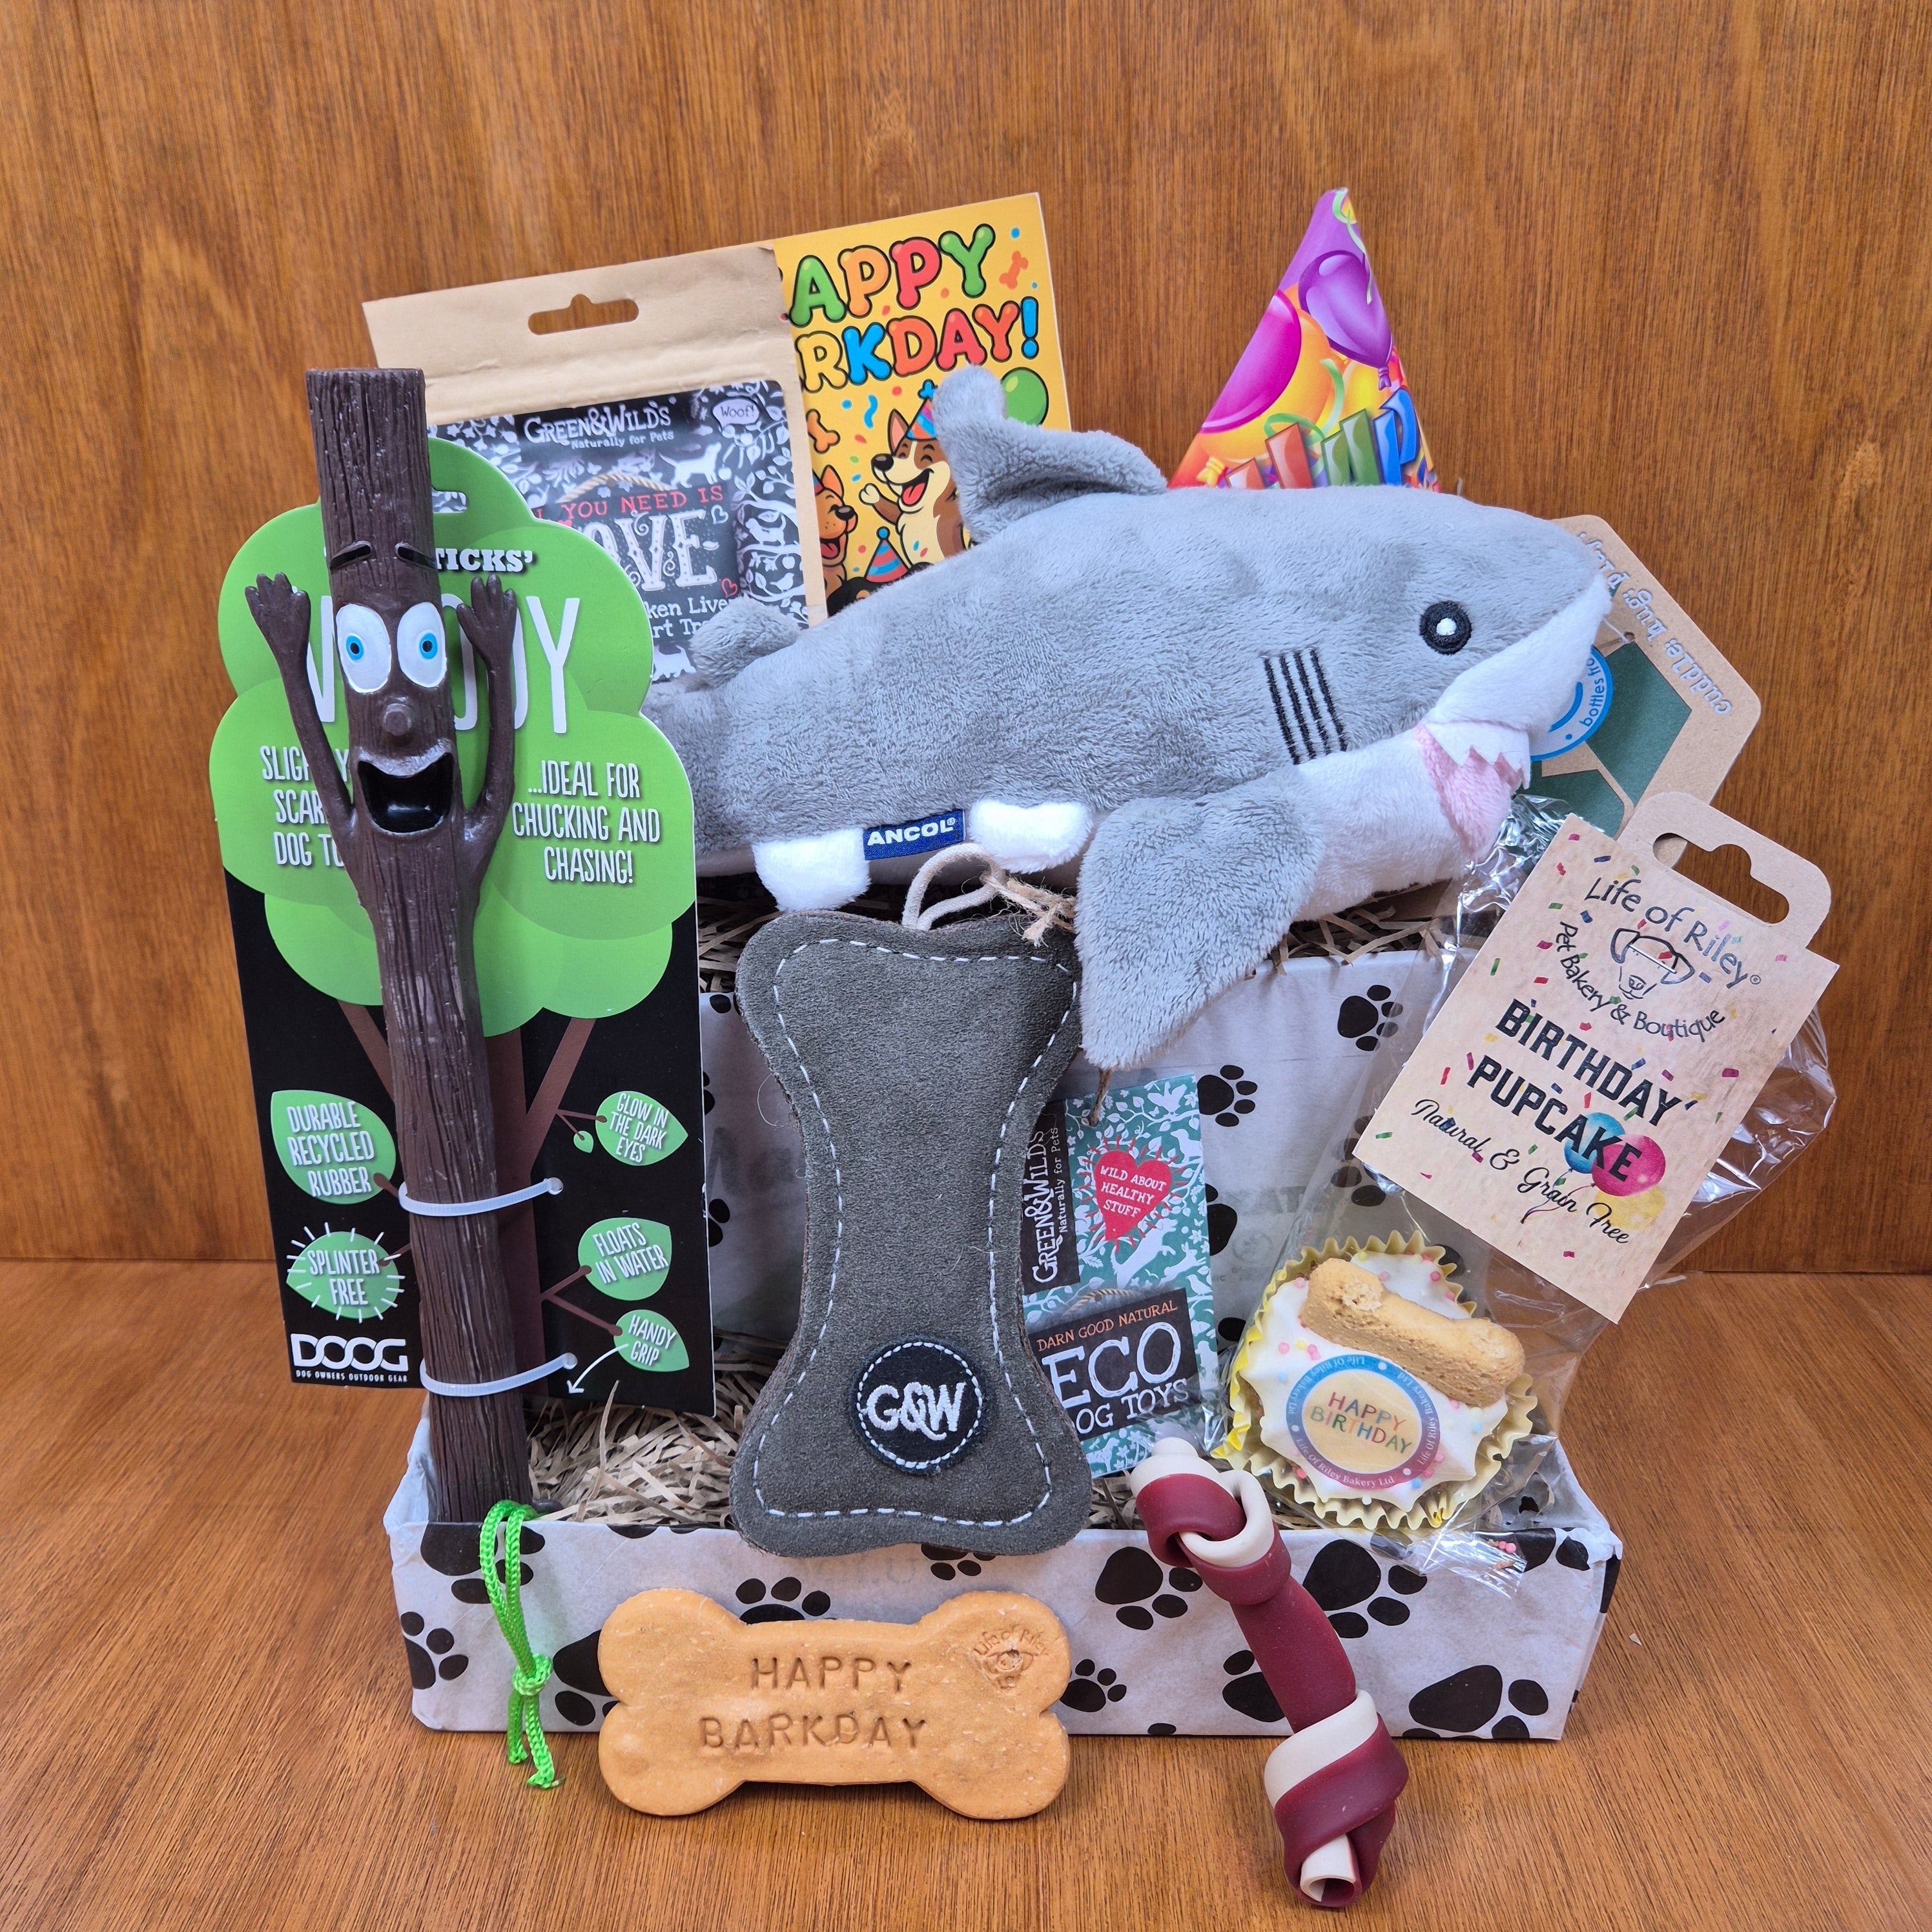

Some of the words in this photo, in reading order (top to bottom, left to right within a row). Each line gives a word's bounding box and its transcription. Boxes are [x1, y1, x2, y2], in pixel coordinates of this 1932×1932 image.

[790, 223, 996, 327] APPY
[795, 296, 1039, 393] RKDAY!
[720, 405, 757, 420] Woof!
[571, 436, 625, 450] Naturally
[629, 435, 646, 446] for
[650, 429, 674, 442] Pets
[561, 500, 608, 520] YOU
[621, 491, 687, 514] NEED
[697, 485, 723, 503] IS
[435, 548, 533, 573] TICKS'
[581, 509, 718, 592] OVE
[1586, 655, 1605, 677] fro
[1579, 677, 1605, 728] bottles
[260, 745, 349, 782] SLIGY
[606, 762, 641, 798] FOR
[512, 802, 609, 841] CHUCKING
[618, 807, 661, 842] AND
[273, 831, 313, 867] DOG
[318, 834, 345, 867] TO
[544, 846, 633, 884] CHASING!
[1584, 877, 1642, 912] Life
[1645, 906, 1695, 932] of
[1556, 921, 1578, 952] Pet
[1560, 953, 1612, 1012] Bakery
[1610, 1004, 1631, 1025] &
[1633, 1009, 1726, 1043] Boutique
[1495, 998, 1683, 1127] BIRTHDAY
[286, 1100, 362, 1133] DURABLE
[616, 1093, 653, 1122] GLOW
[653, 1107, 670, 1129] IN
[1466, 1054, 1642, 1182] PUPCAKE
[287, 1130, 375, 1166] RECYCLED
[609, 1111, 633, 1136] THE
[633, 1121, 667, 1150] DARK
[1051, 1127, 1061, 1153] Pets
[615, 1136, 646, 1163] EYES
[1053, 1158, 1062, 1175] for
[307, 1166, 372, 1198] RUBBER
[1100, 1165, 1128, 1181] WILD
[1130, 1174, 1167, 1192] ABOUT
[1411, 1098, 1492, 1154] Natural
[1489, 1148, 1521, 1171] &
[1517, 1166, 1577, 1213] Grain
[1585, 1202, 1629, 1244] Free
[1053, 1178, 1068, 1233] Naturally
[1100, 1182, 1155, 1205] HEALTHY
[1103, 1199, 1142, 1218] STUFF
[592, 1222, 647, 1257] FLOATS
[307, 1249, 380, 1276] SPLINTER
[595, 1259, 617, 1284] IN
[613, 1244, 669, 1279] WATER
[329, 1278, 369, 1306] FREE
[628, 1314, 677, 1350] HANDY
[1036, 1329, 1075, 1352] DARN
[1078, 1318, 1115, 1338] GOOD
[1118, 1299, 1178, 1327] NATURAL
[290, 1333, 409, 1372] DOOG
[630, 1340, 661, 1367] GRIP
[1042, 1321, 1182, 1409] ECO
[1309, 1361, 1333, 1378] Riley
[1333, 1357, 1345, 1366] Of
[1346, 1356, 1366, 1365] Life
[296, 1369, 313, 1378] DOG
[314, 1371, 346, 1381] OWNERS
[348, 1373, 385, 1382] OUTDOOR
[1291, 1375, 1313, 1401] Bakery
[1397, 1371, 1415, 1388] Ltd
[866, 1382, 967, 1441] G&W
[1074, 1403, 1114, 1435] OG
[1121, 1377, 1189, 1420] TOYS
[1288, 1401, 1297, 1415] Ltd
[1328, 1392, 1406, 1432] HAPPY
[1413, 1385, 1434, 1415] Bakery
[1310, 1406, 1413, 1454] BIRTHDAY
[1427, 1415, 1437, 1438] Riley
[1428, 1438, 1437, 1450] Of
[1295, 1439, 1309, 1454] Life
[1308, 1452, 1319, 1465] Of
[1318, 1462, 1342, 1481] Riley
[1342, 1475, 1377, 1488] Bakery
[1378, 1475, 1395, 1486] Ltd
[1418, 1450, 1433, 1466] Life
[748, 1656, 913, 1693] HAPPY
[698, 1712, 929, 1751] BARKDAY
